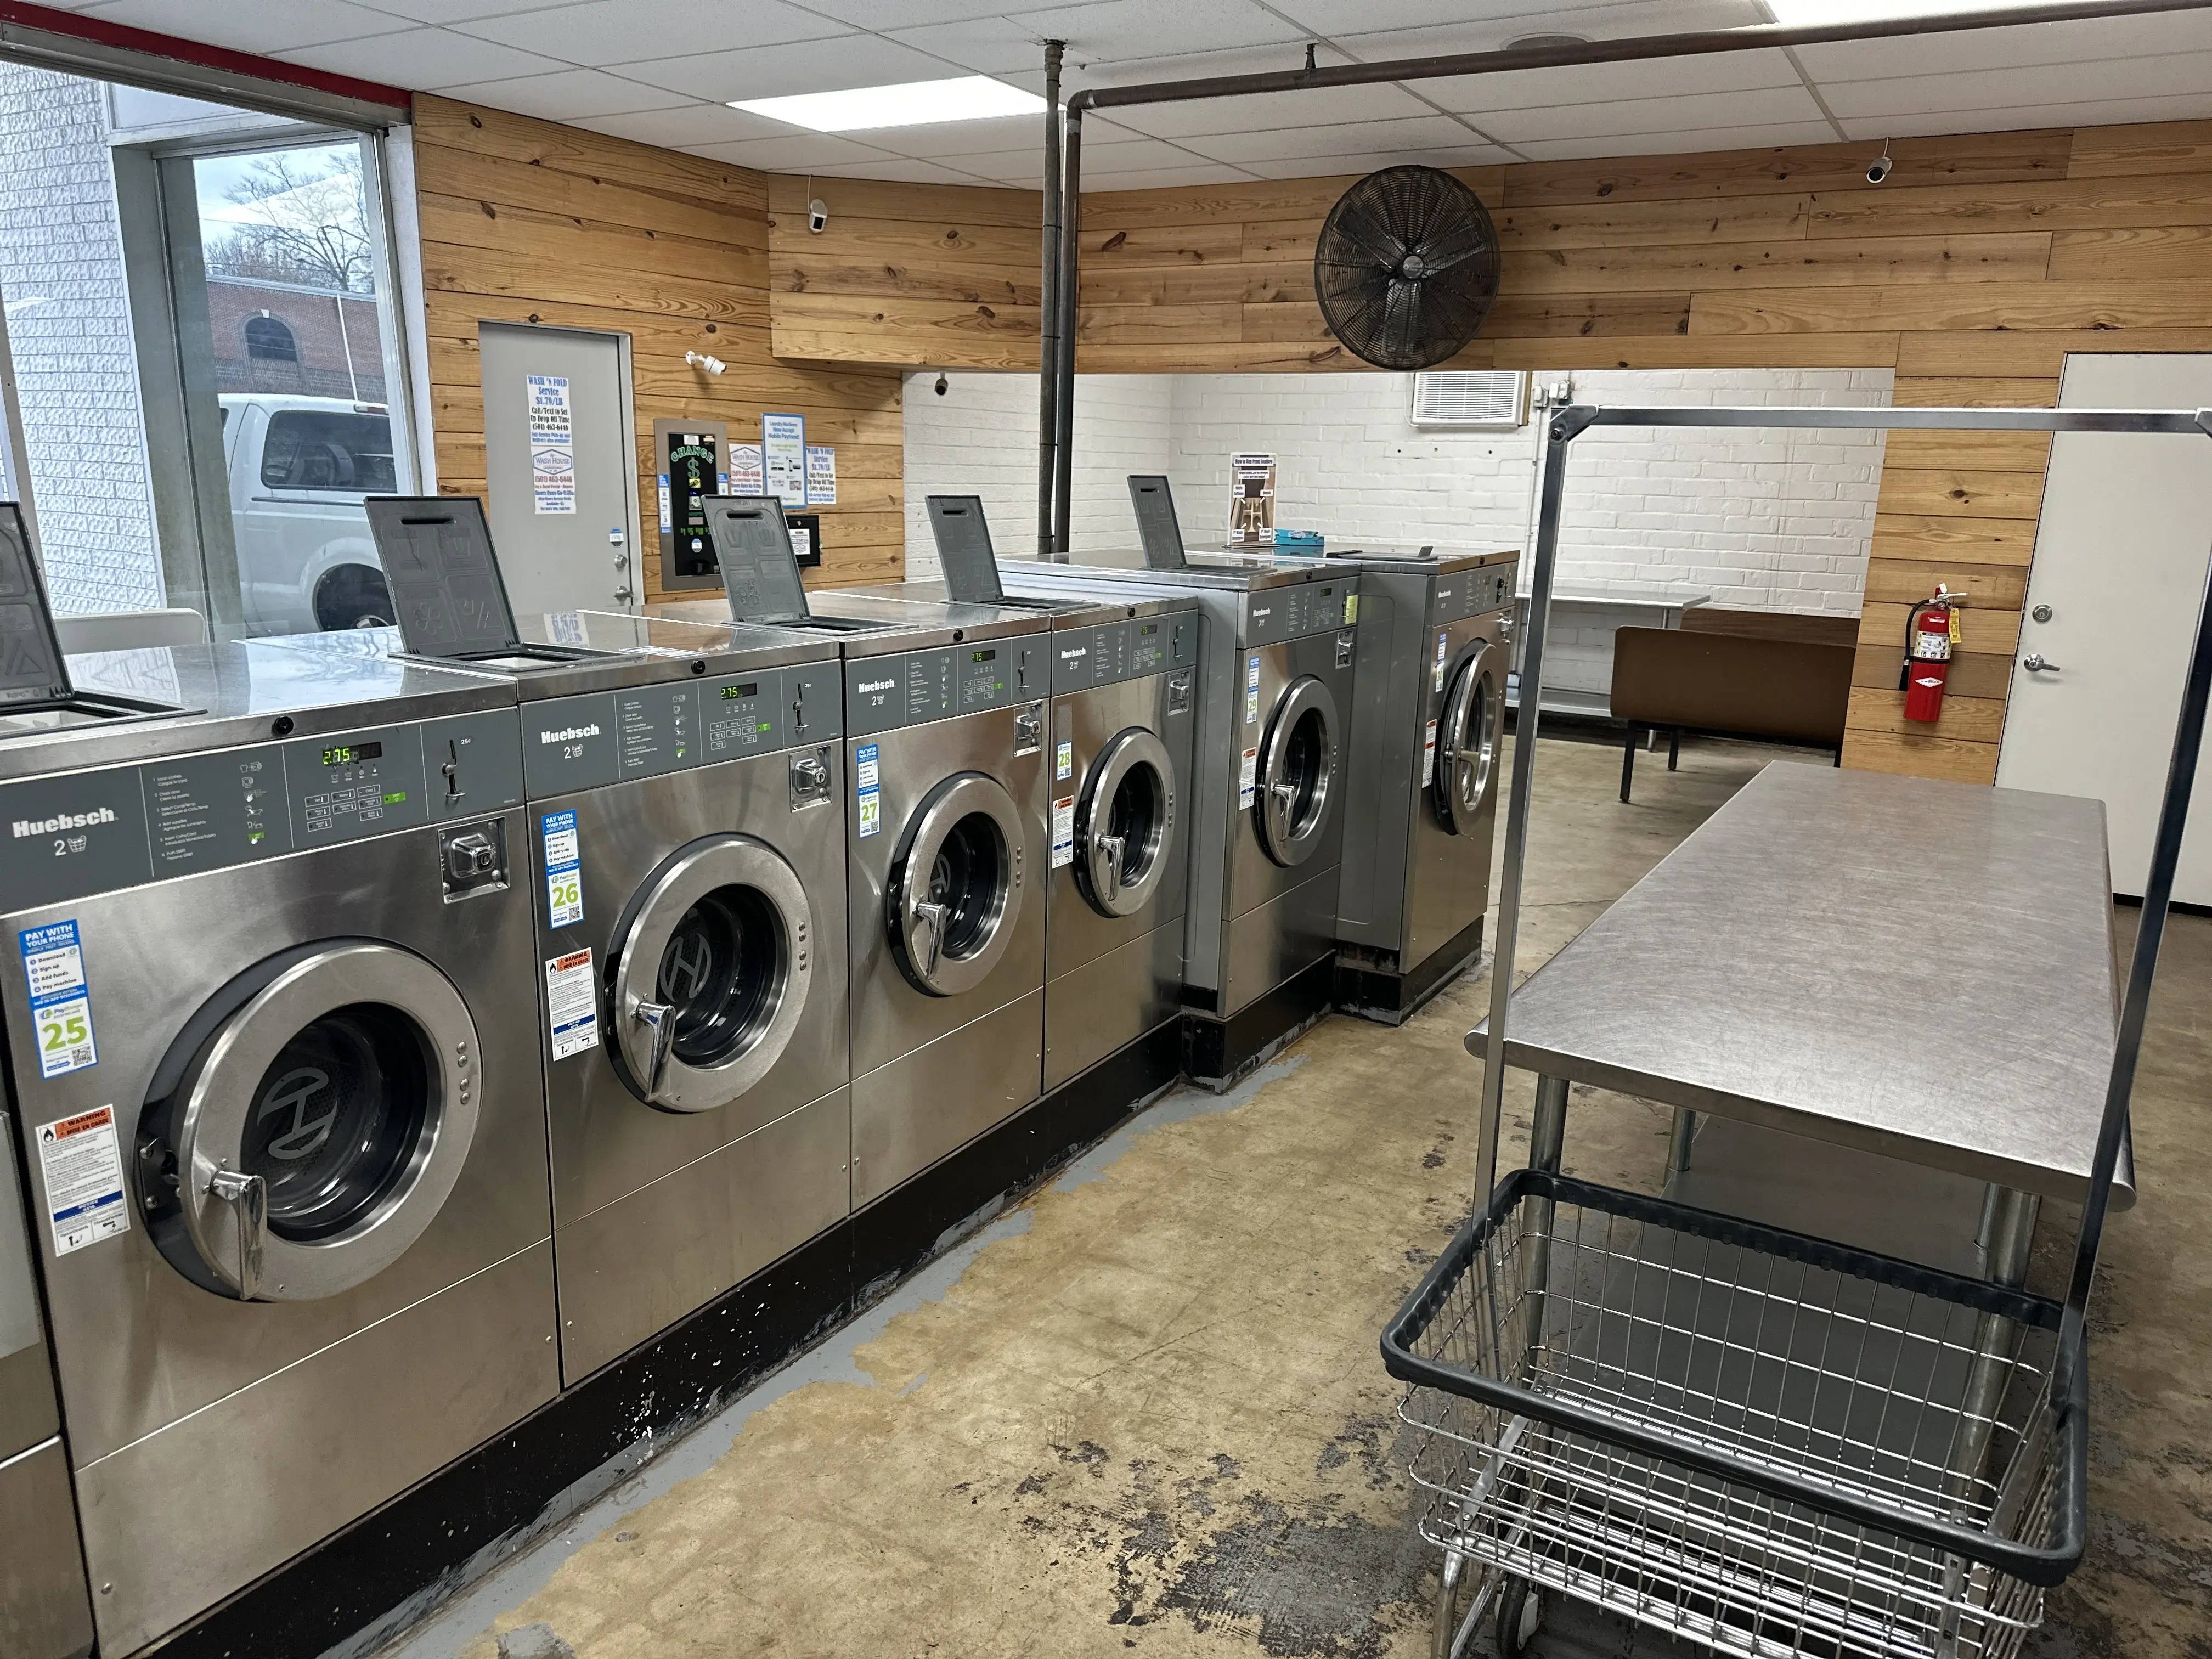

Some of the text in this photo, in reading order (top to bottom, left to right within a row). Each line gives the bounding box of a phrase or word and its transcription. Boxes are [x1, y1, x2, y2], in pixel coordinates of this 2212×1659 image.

[528, 376, 545, 385] WASH
[554, 379, 567, 387] FOLD
[538, 387, 560, 396] Service
[535, 396, 563, 405] $1.79/LB
[670, 445, 714, 464] CHANGE
[687, 457, 701, 478] $
[1061, 647, 1086, 659] Huebsch
[859, 679, 895, 693] Huebsch
[872, 696, 877, 706] 2
[1248, 699, 1256, 712] 29
[541, 724, 600, 743] Huebsch
[563, 747, 571, 759] 2
[1058, 752, 1070, 767] 28
[545, 812, 573, 824] PAY WITH
[861, 802, 877, 822] 27
[12, 806, 116, 838] Huebsch
[54, 839, 66, 857] 2
[552, 883, 579, 908] 26
[25, 924, 73, 941] PAY WITH
[26, 932, 75, 947] YOUR PHONE
[38, 952, 66, 963] Download
[564, 952, 587, 963] WARNING
[54, 978, 77, 987] machine
[42, 1015, 87, 1052] 25
[67, 1110, 106, 1126] WARNING
[66, 1127, 81, 1136] MISE
[91, 1118, 109, 1128] GARDE
